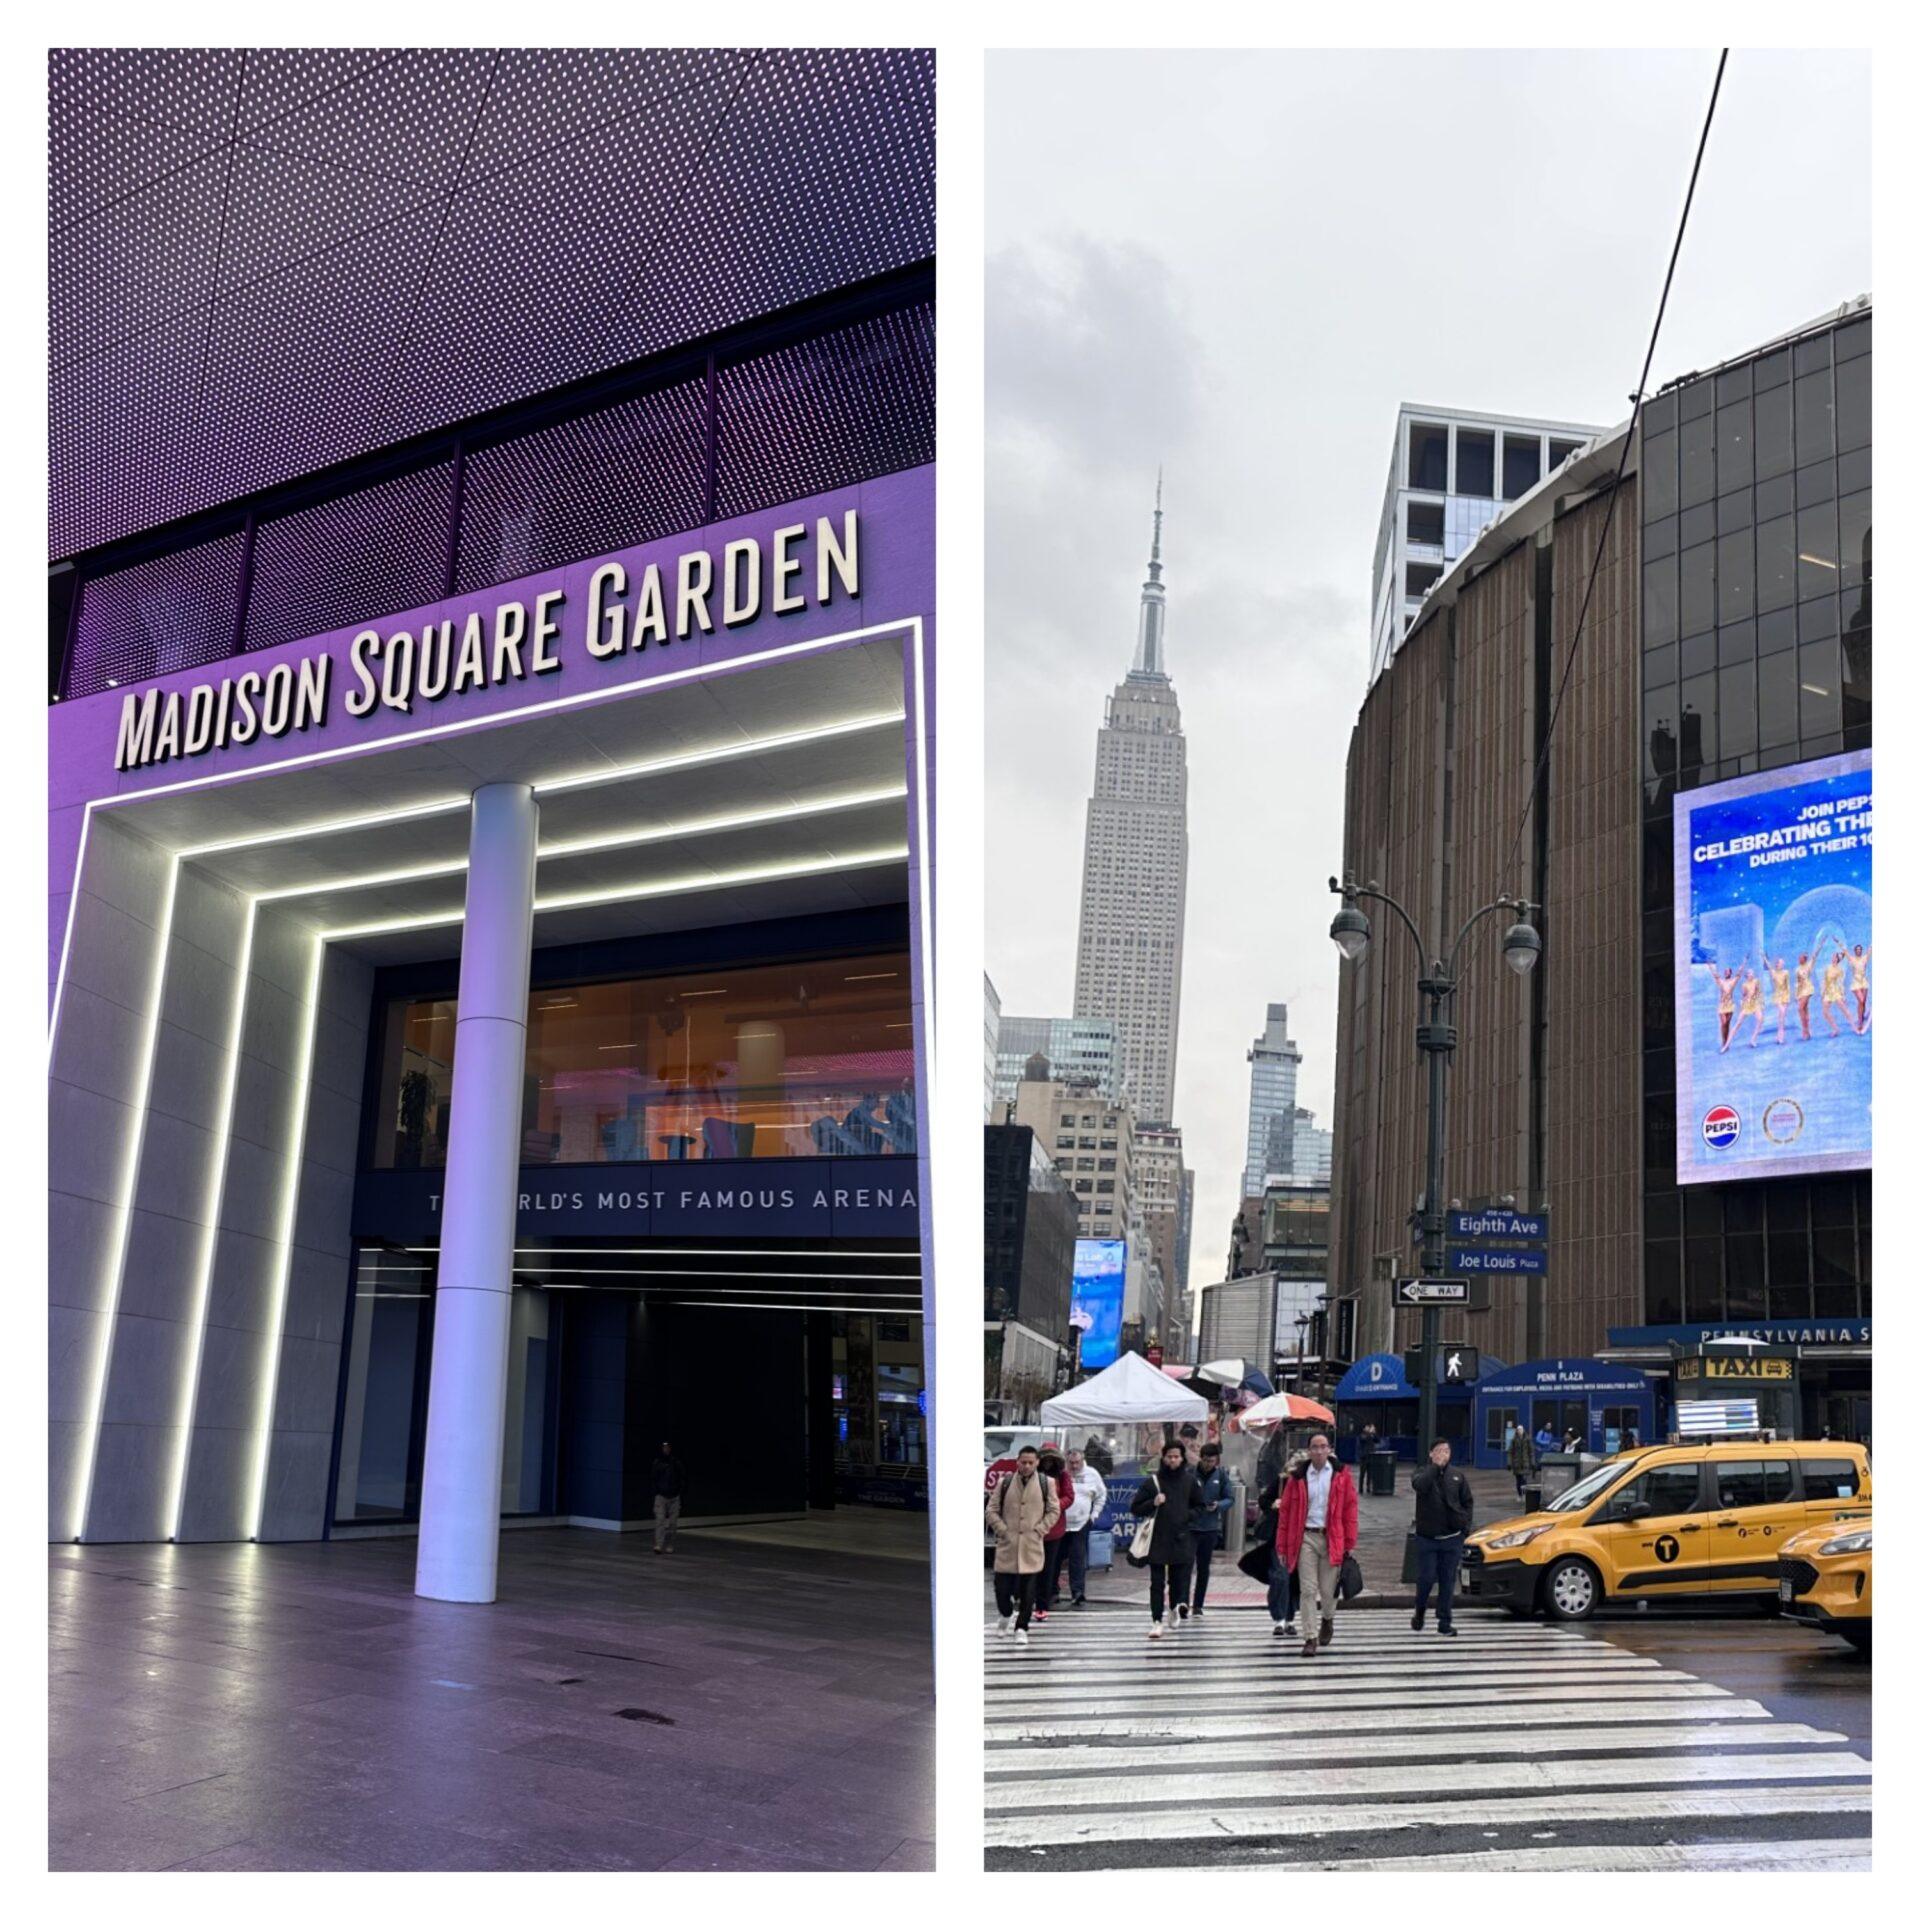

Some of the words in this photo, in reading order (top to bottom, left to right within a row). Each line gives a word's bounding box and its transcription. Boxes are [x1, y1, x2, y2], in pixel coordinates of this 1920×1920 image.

[114, 652, 331, 771] MADISON
[345, 589, 565, 716] SQUARE
[585, 509, 859, 658] GARDEN
[1797, 801, 1834, 821] JOIN
[1694, 820, 1832, 863] CELEBRATING
[1750, 846, 1807, 868] DURING
[1810, 836, 1857, 855] THEIR
[1705, 1121, 1738, 1133] PEPSI
[518, 1193, 584, 1210] RLD'S
[598, 1191, 665, 1209] MOST
[680, 1189, 794, 1208] FAMOUS
[812, 1188, 918, 1208] ARENA
[1459, 1216, 1506, 1235] Eighth
[1510, 1219, 1538, 1233] Ave
[1459, 1254, 1480, 1268] Joe
[1484, 1254, 1516, 1269] Louis
[1409, 1286, 1428, 1296] ONE
[1438, 1286, 1459, 1295] WAY
[1371, 1362, 1382, 1382] D
[1559, 1371, 1584, 1381] PLAZA
[1711, 1358, 1762, 1376] TAXI
[1660, 1540, 1674, 1560] T
